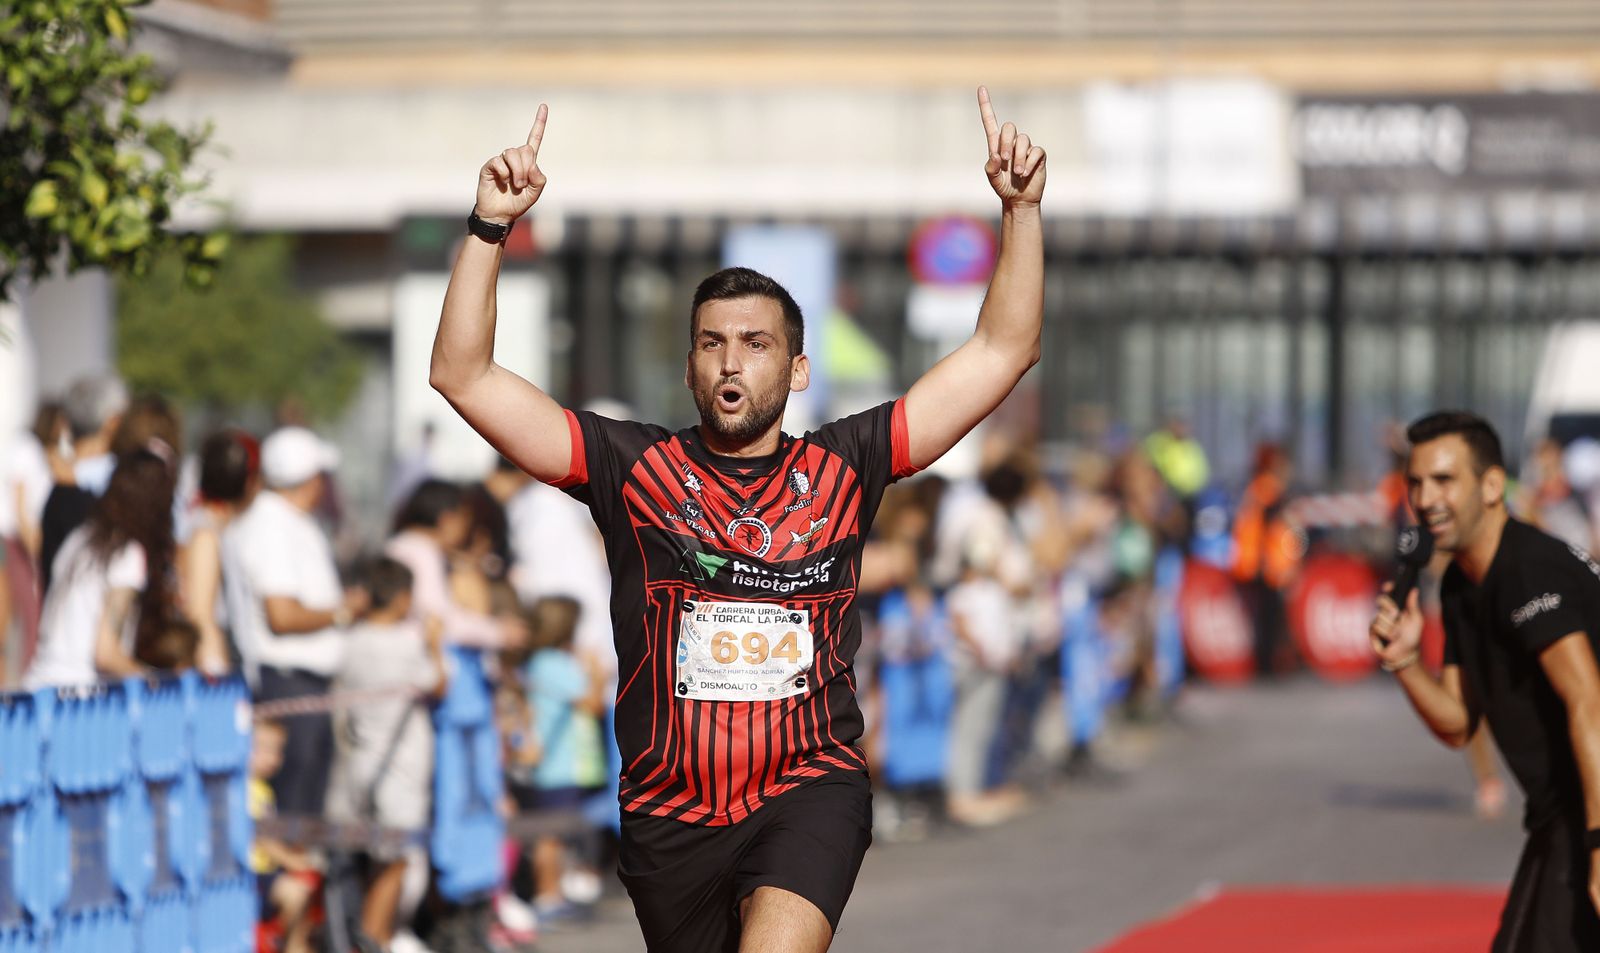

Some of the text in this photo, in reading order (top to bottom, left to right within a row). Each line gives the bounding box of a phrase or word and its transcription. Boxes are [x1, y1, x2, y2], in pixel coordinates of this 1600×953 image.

[665, 510, 684, 523] LAS
[685, 518, 716, 539] VEGAS
[716, 606, 756, 616] CARRERA
[696, 613, 709, 623] EL
[712, 614, 753, 624] TORCAL
[758, 615, 771, 624] LA
[710, 630, 802, 666] 694
[700, 681, 758, 691] DISMOAUTO
